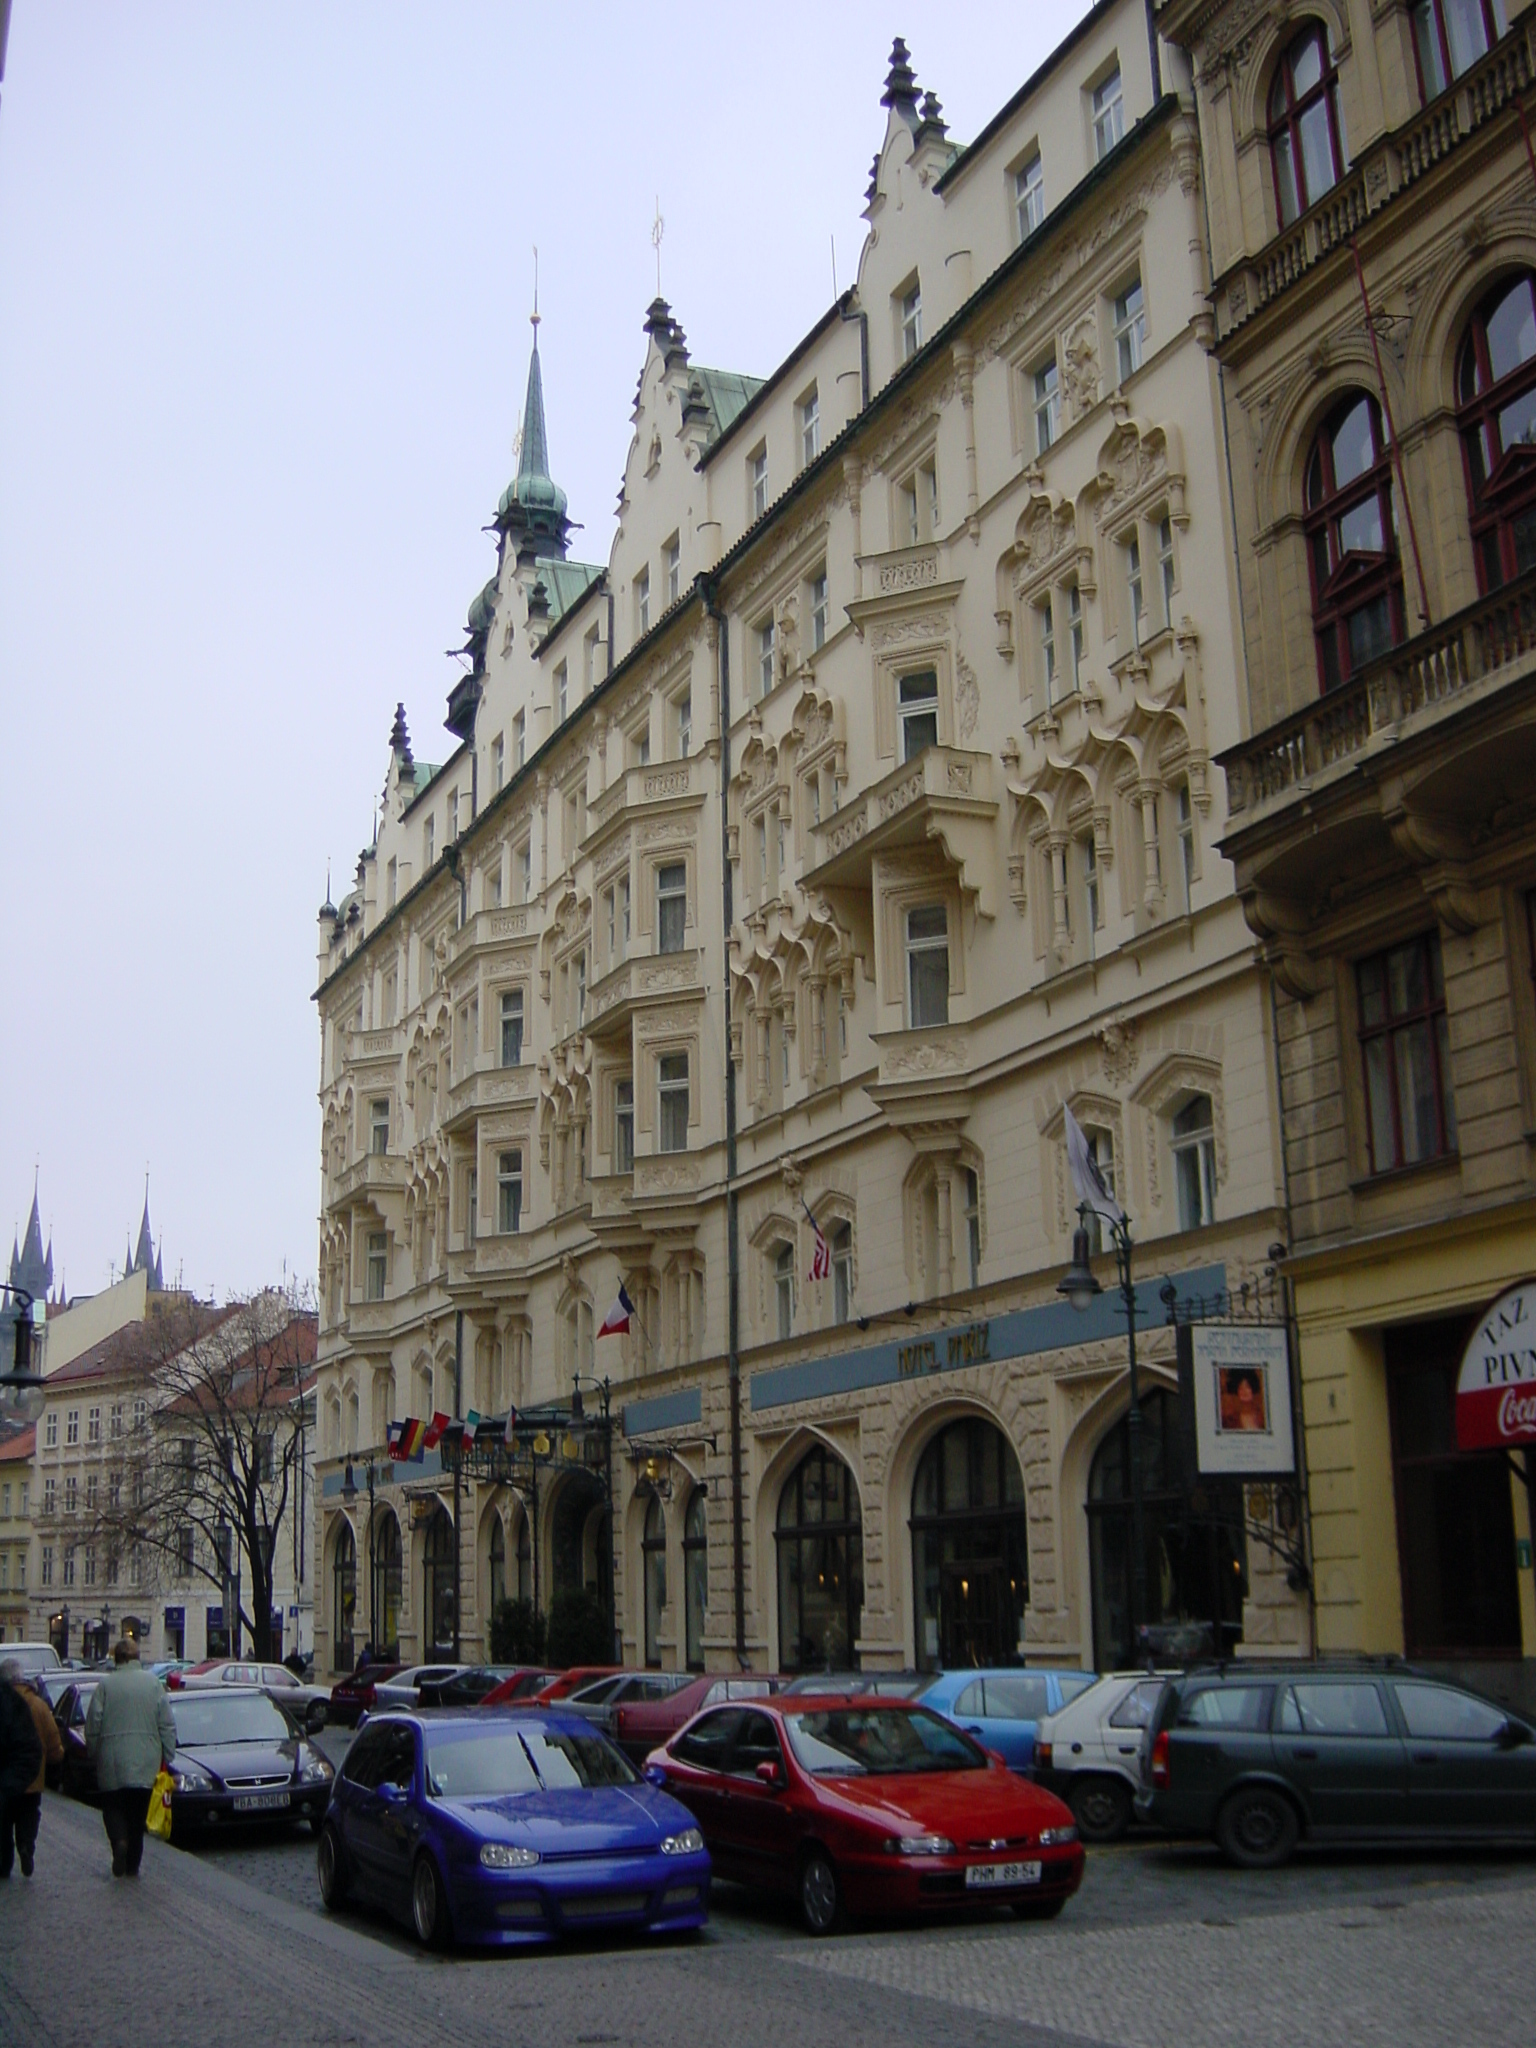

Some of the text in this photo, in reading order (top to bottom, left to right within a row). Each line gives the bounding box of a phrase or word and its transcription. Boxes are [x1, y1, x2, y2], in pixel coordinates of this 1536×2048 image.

[897, 1341, 941, 1374] HOTEL
[972, 1862, 1035, 1882] PHM 89-54
